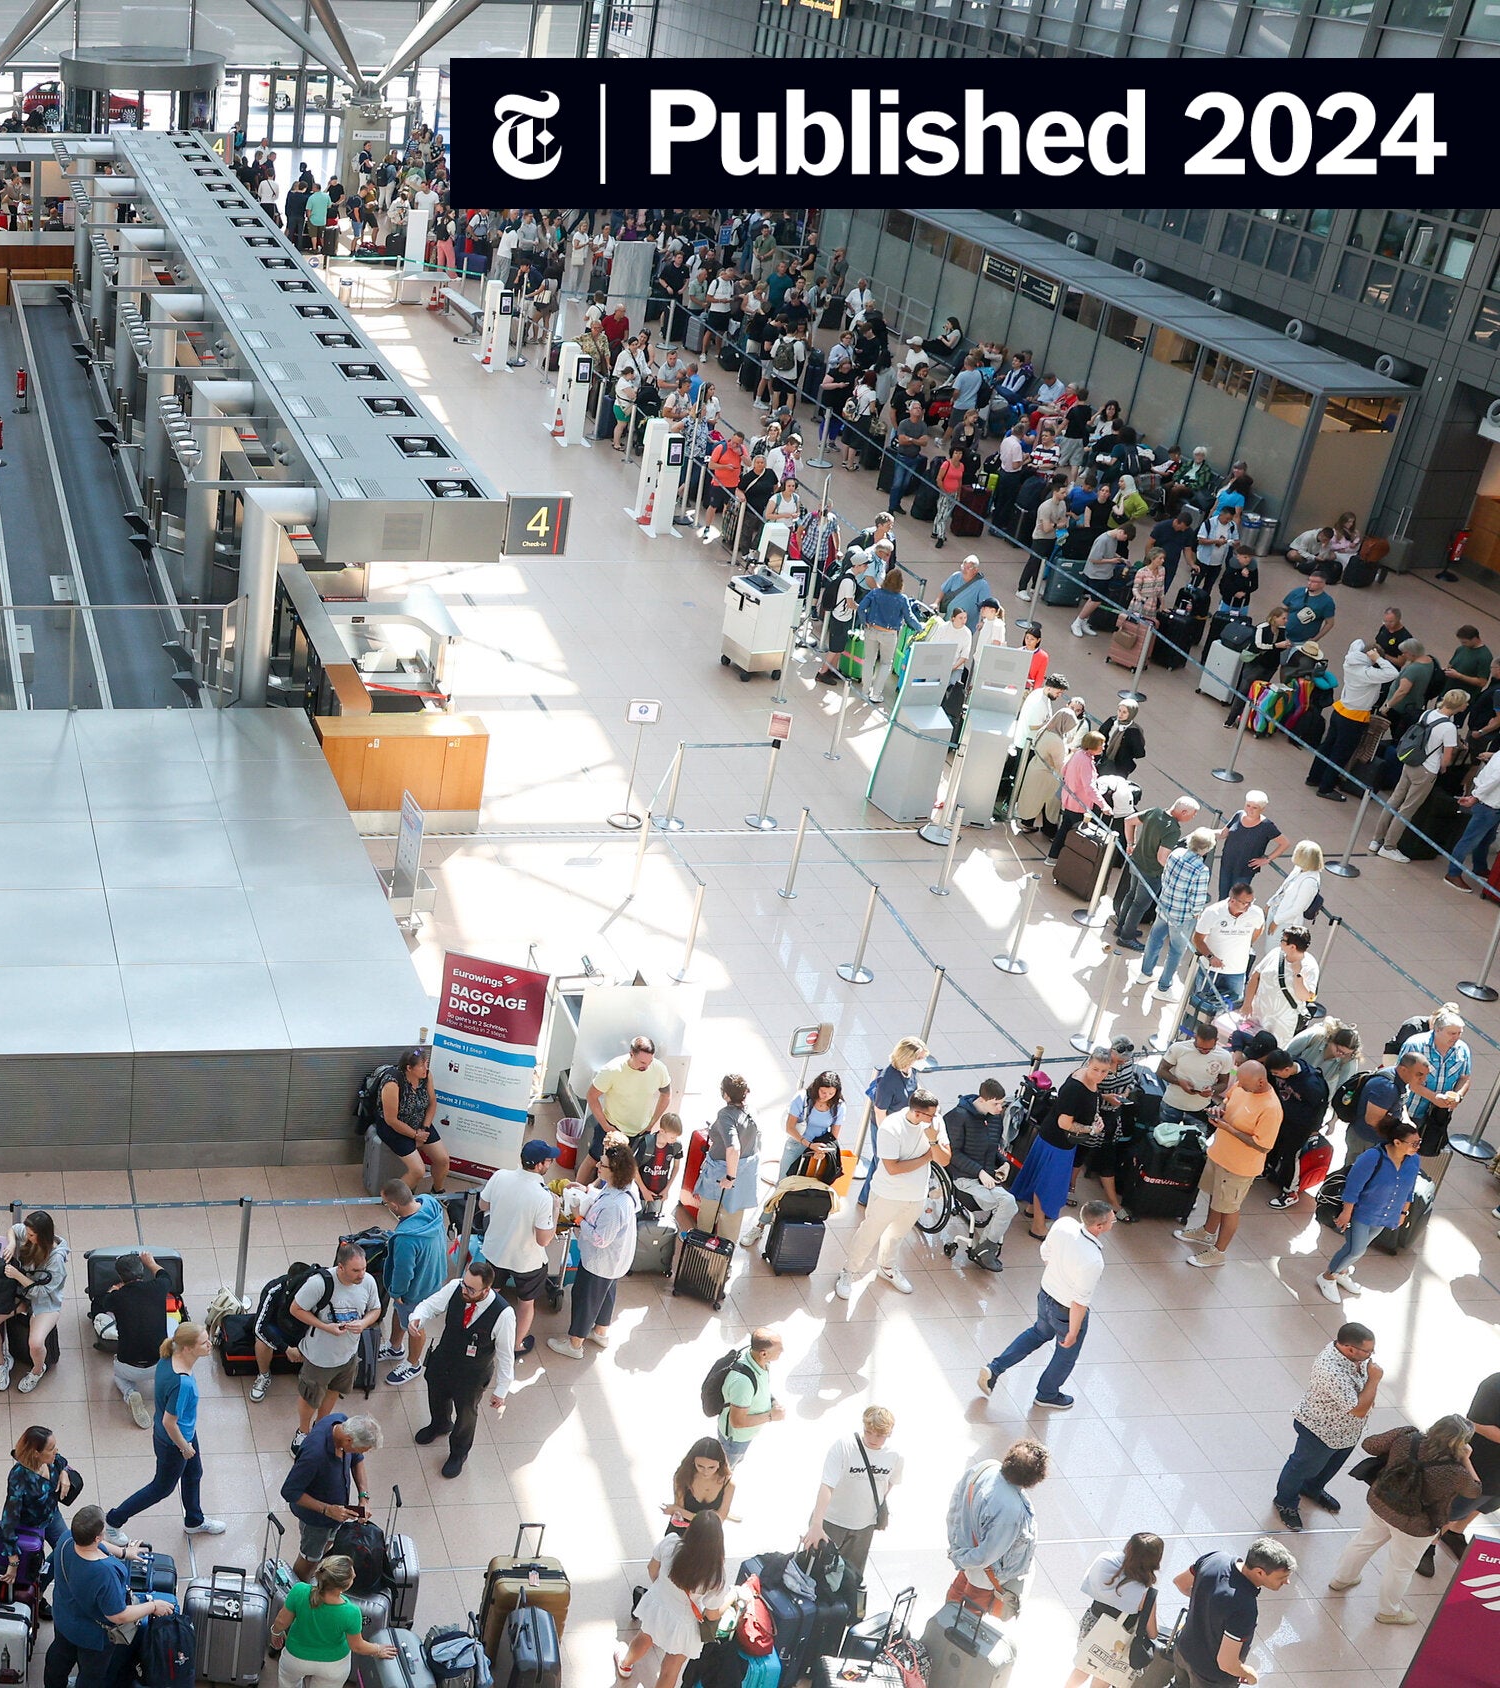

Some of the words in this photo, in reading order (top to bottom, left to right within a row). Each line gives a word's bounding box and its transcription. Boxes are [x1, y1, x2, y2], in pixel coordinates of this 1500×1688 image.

[212, 138, 225, 155] 4
[526, 506, 550, 537] 4
[452, 968, 503, 988] Eurowings
[450, 982, 527, 1011] BAGGAGE
[447, 1011, 454, 1019] So
[448, 996, 491, 1017] DROP
[446, 1018, 458, 1026] How
[443, 1039, 462, 1050] Schritt
[469, 1047, 483, 1055] Step
[462, 1100, 476, 1109] Step
